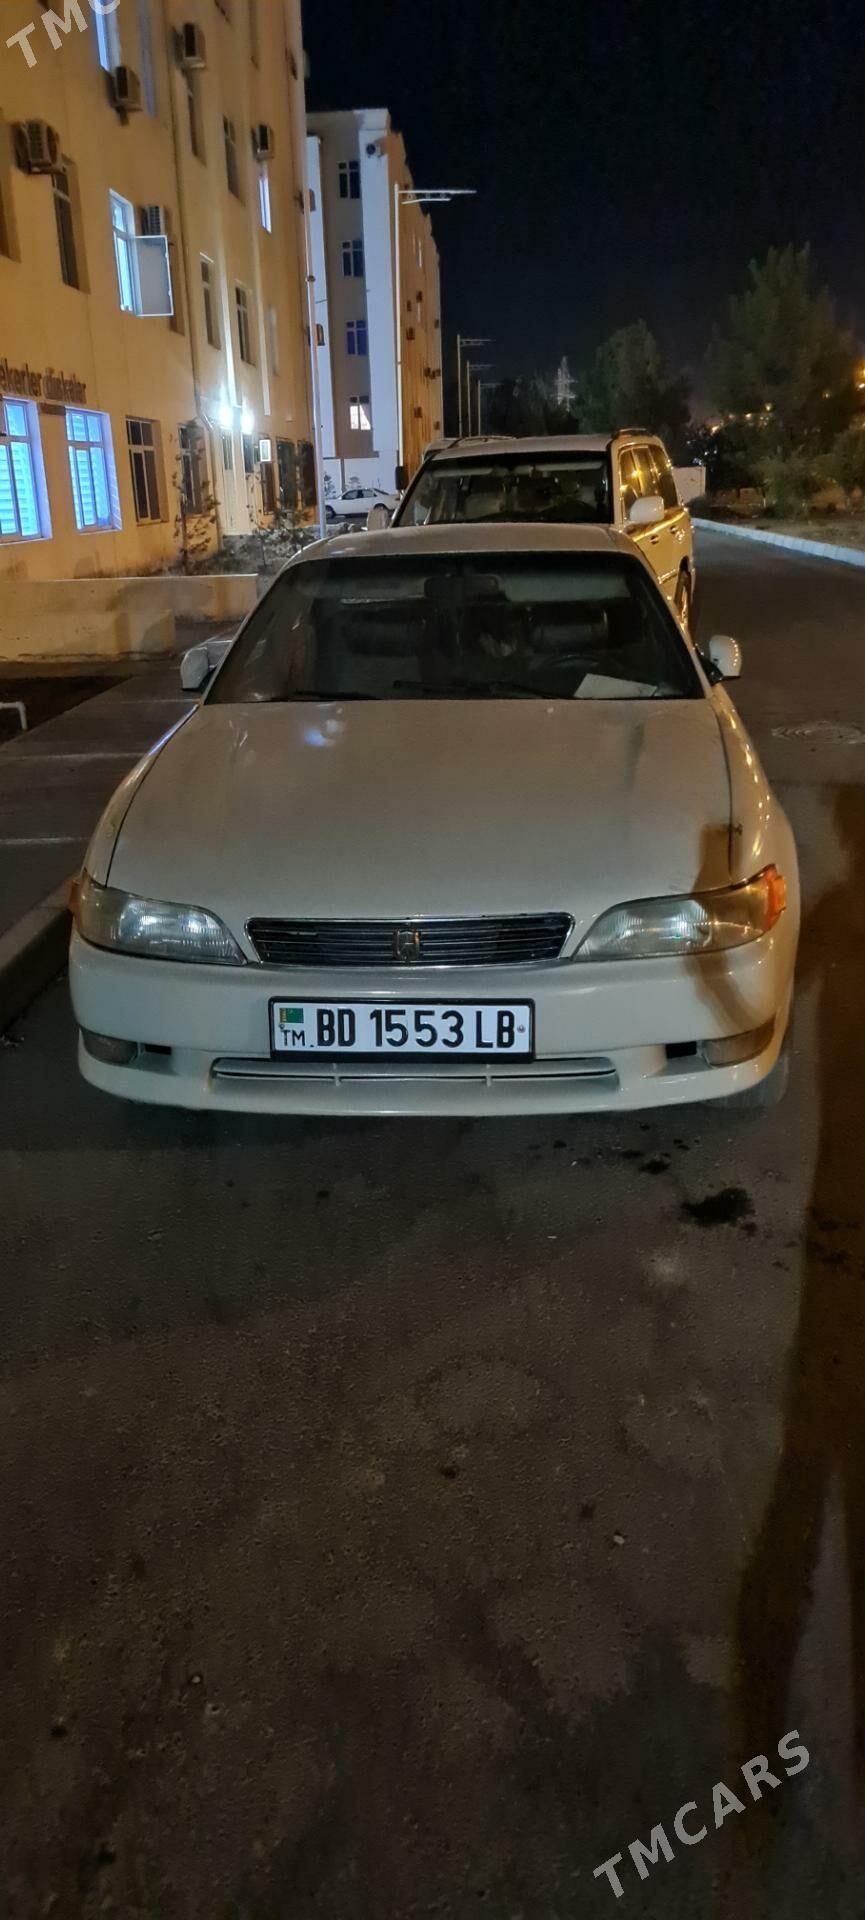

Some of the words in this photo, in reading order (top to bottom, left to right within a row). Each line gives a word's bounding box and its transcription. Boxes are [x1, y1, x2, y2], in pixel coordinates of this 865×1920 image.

[283, 1030, 305, 1047] TM
[316, 1009, 356, 1047] BD
[369, 1009, 464, 1048] 1553
[475, 1010, 515, 1049] LB
